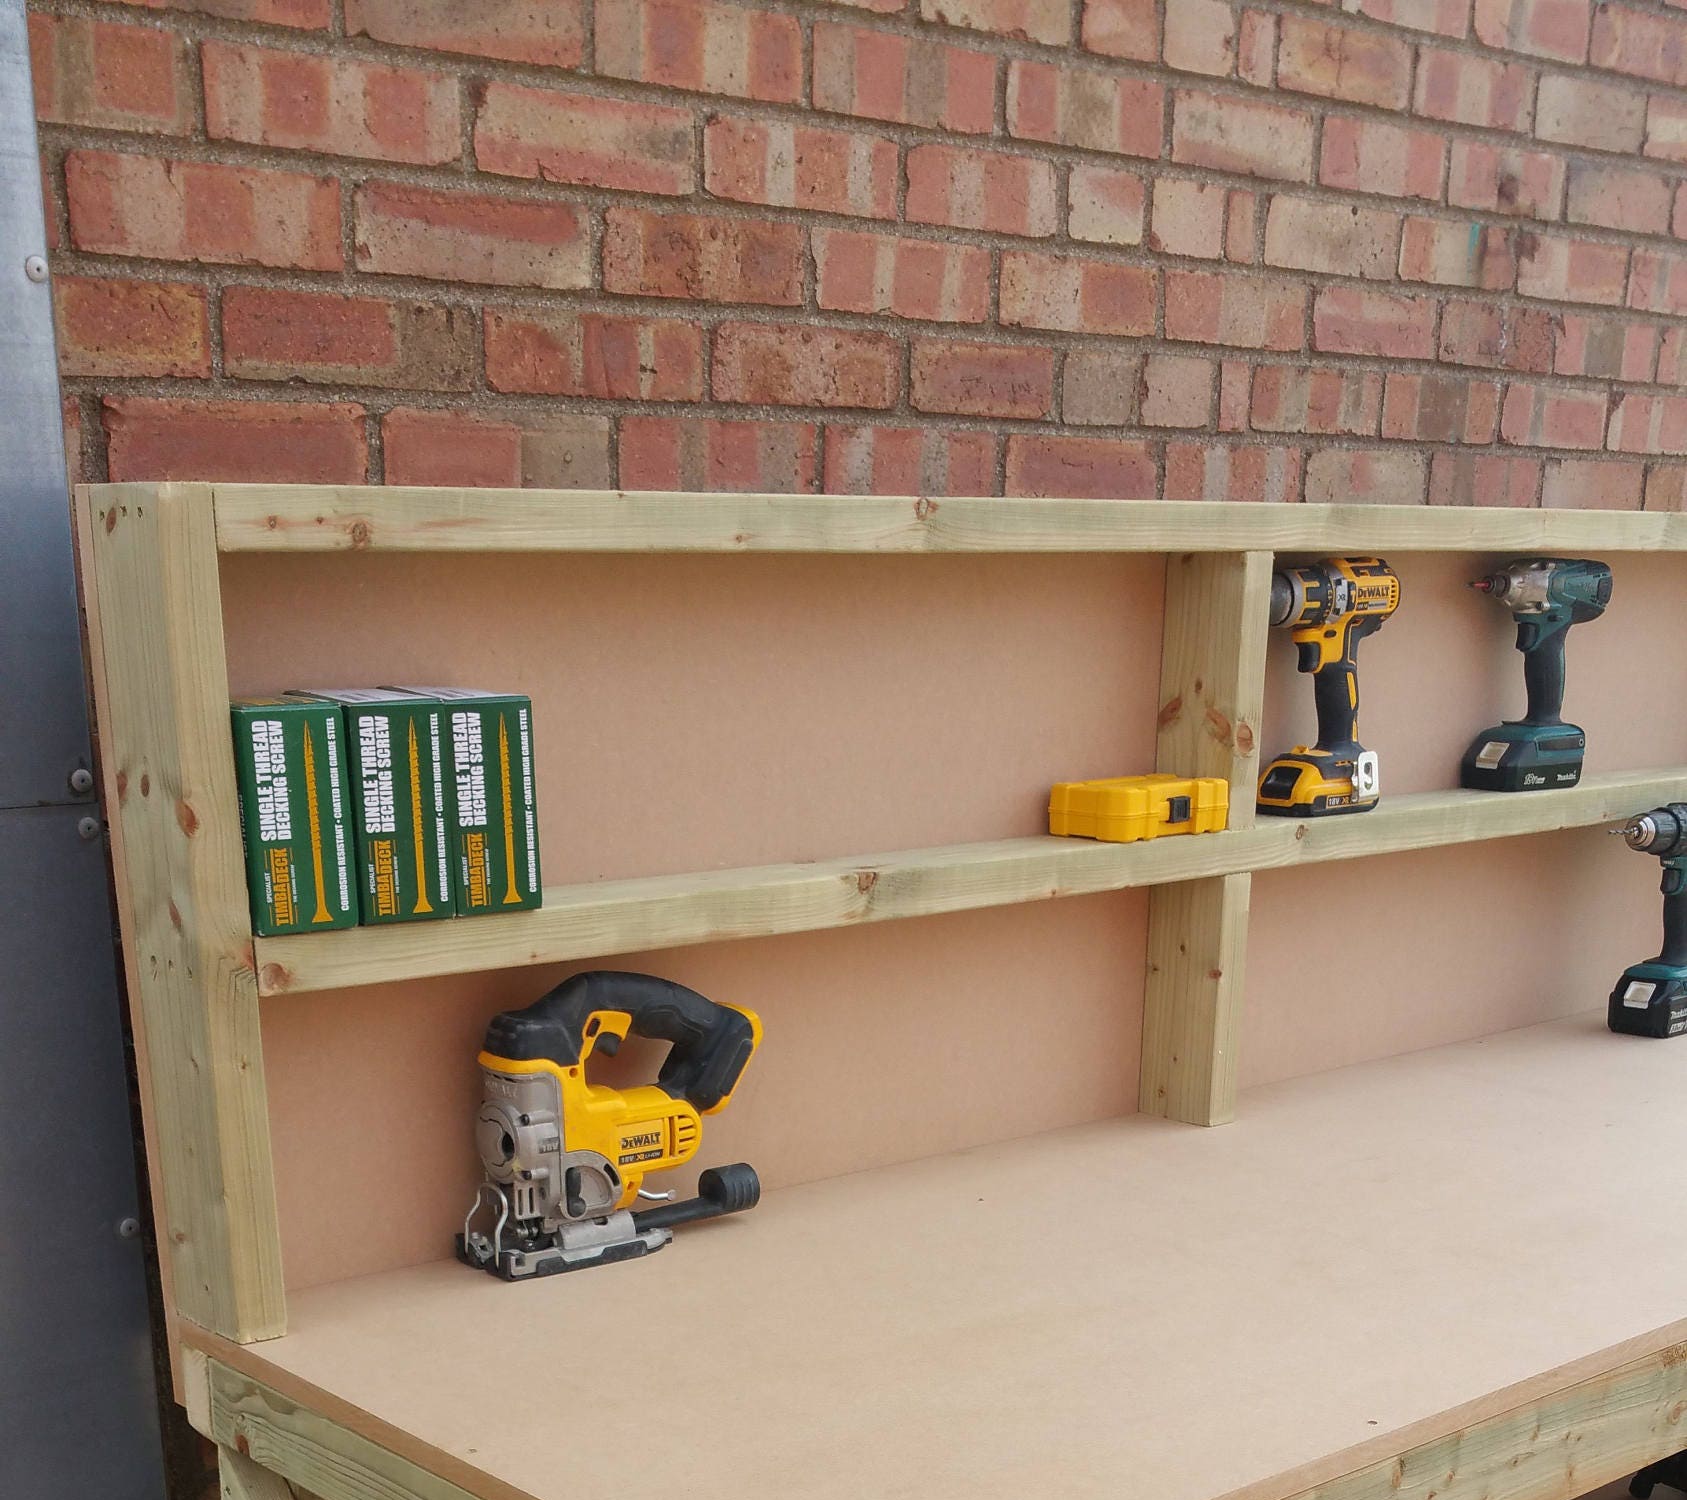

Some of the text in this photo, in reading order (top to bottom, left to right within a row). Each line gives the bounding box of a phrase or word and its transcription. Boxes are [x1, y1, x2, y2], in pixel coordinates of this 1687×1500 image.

[251, 720, 276, 841] SINGLE THREAD
[267, 720, 292, 840] DECKING SCREW
[325, 716, 350, 911] CORROSION RESISTANT COATED HIGH GRADE STEEL
[358, 715, 381, 833] SINGLE THREAD
[374, 715, 396, 833] DECKING SCREW
[429, 713, 449, 902] CORROSION RESISTANT COATED HIGH GRADE STEEL
[451, 712, 474, 827] SINGLE THREAD
[467, 712, 487, 826] DECKING SCREW
[519, 708, 537, 893] CORROSION RESISTANT COATED HIGH GRADE STEEL
